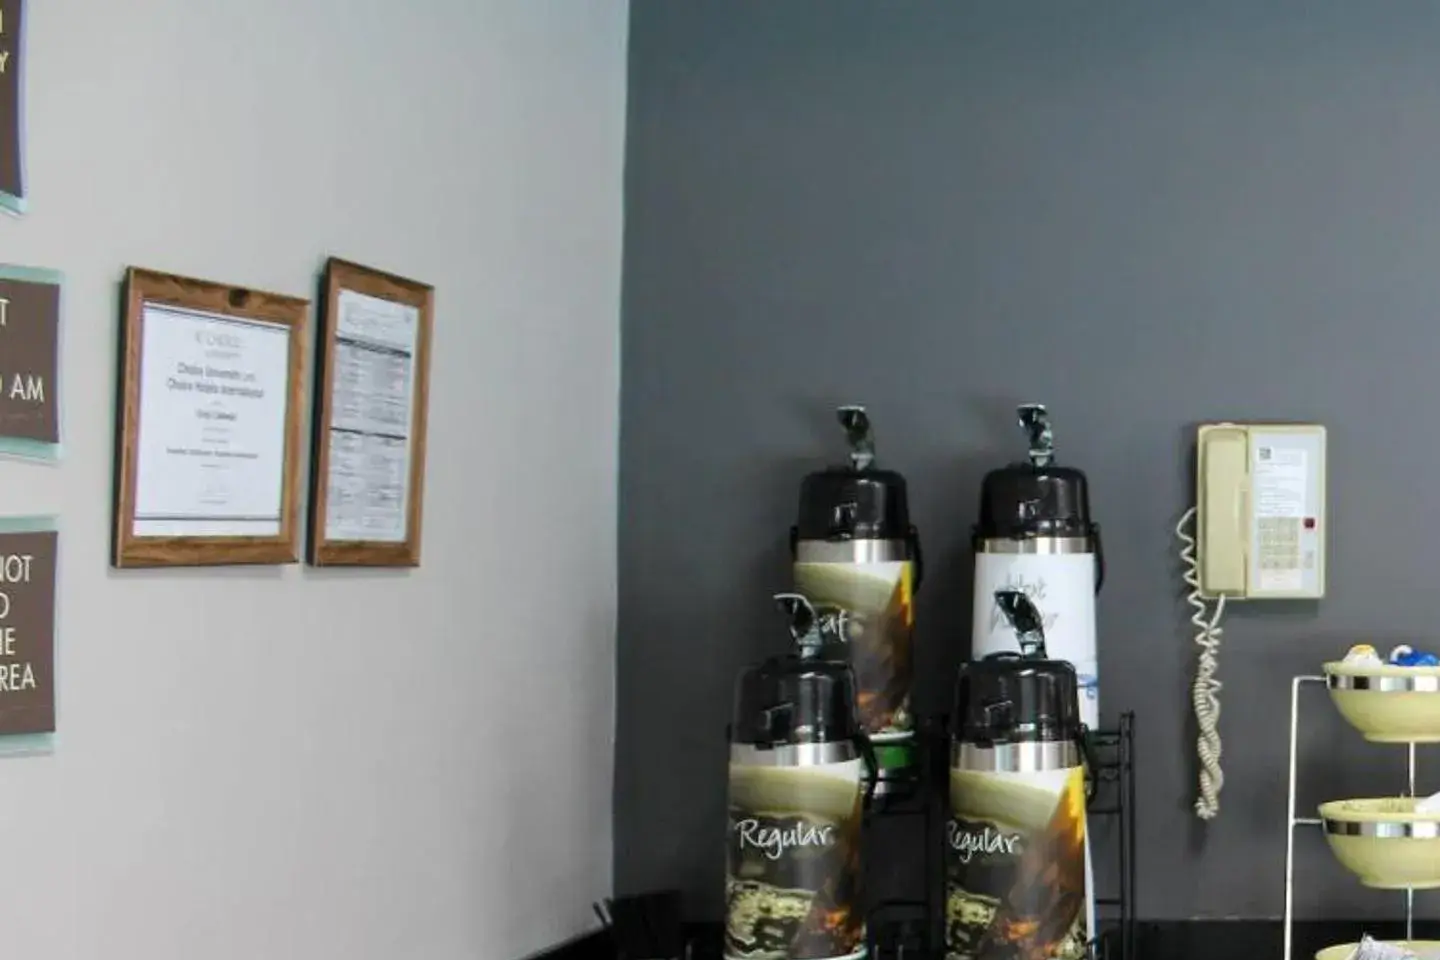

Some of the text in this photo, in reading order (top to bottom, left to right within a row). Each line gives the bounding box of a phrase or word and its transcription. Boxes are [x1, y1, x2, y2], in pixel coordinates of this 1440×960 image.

[9, 372, 44, 402] AM
[0, 554, 34, 583] OT
[0, 661, 37, 692] REA
[736, 818, 832, 860] Regular
